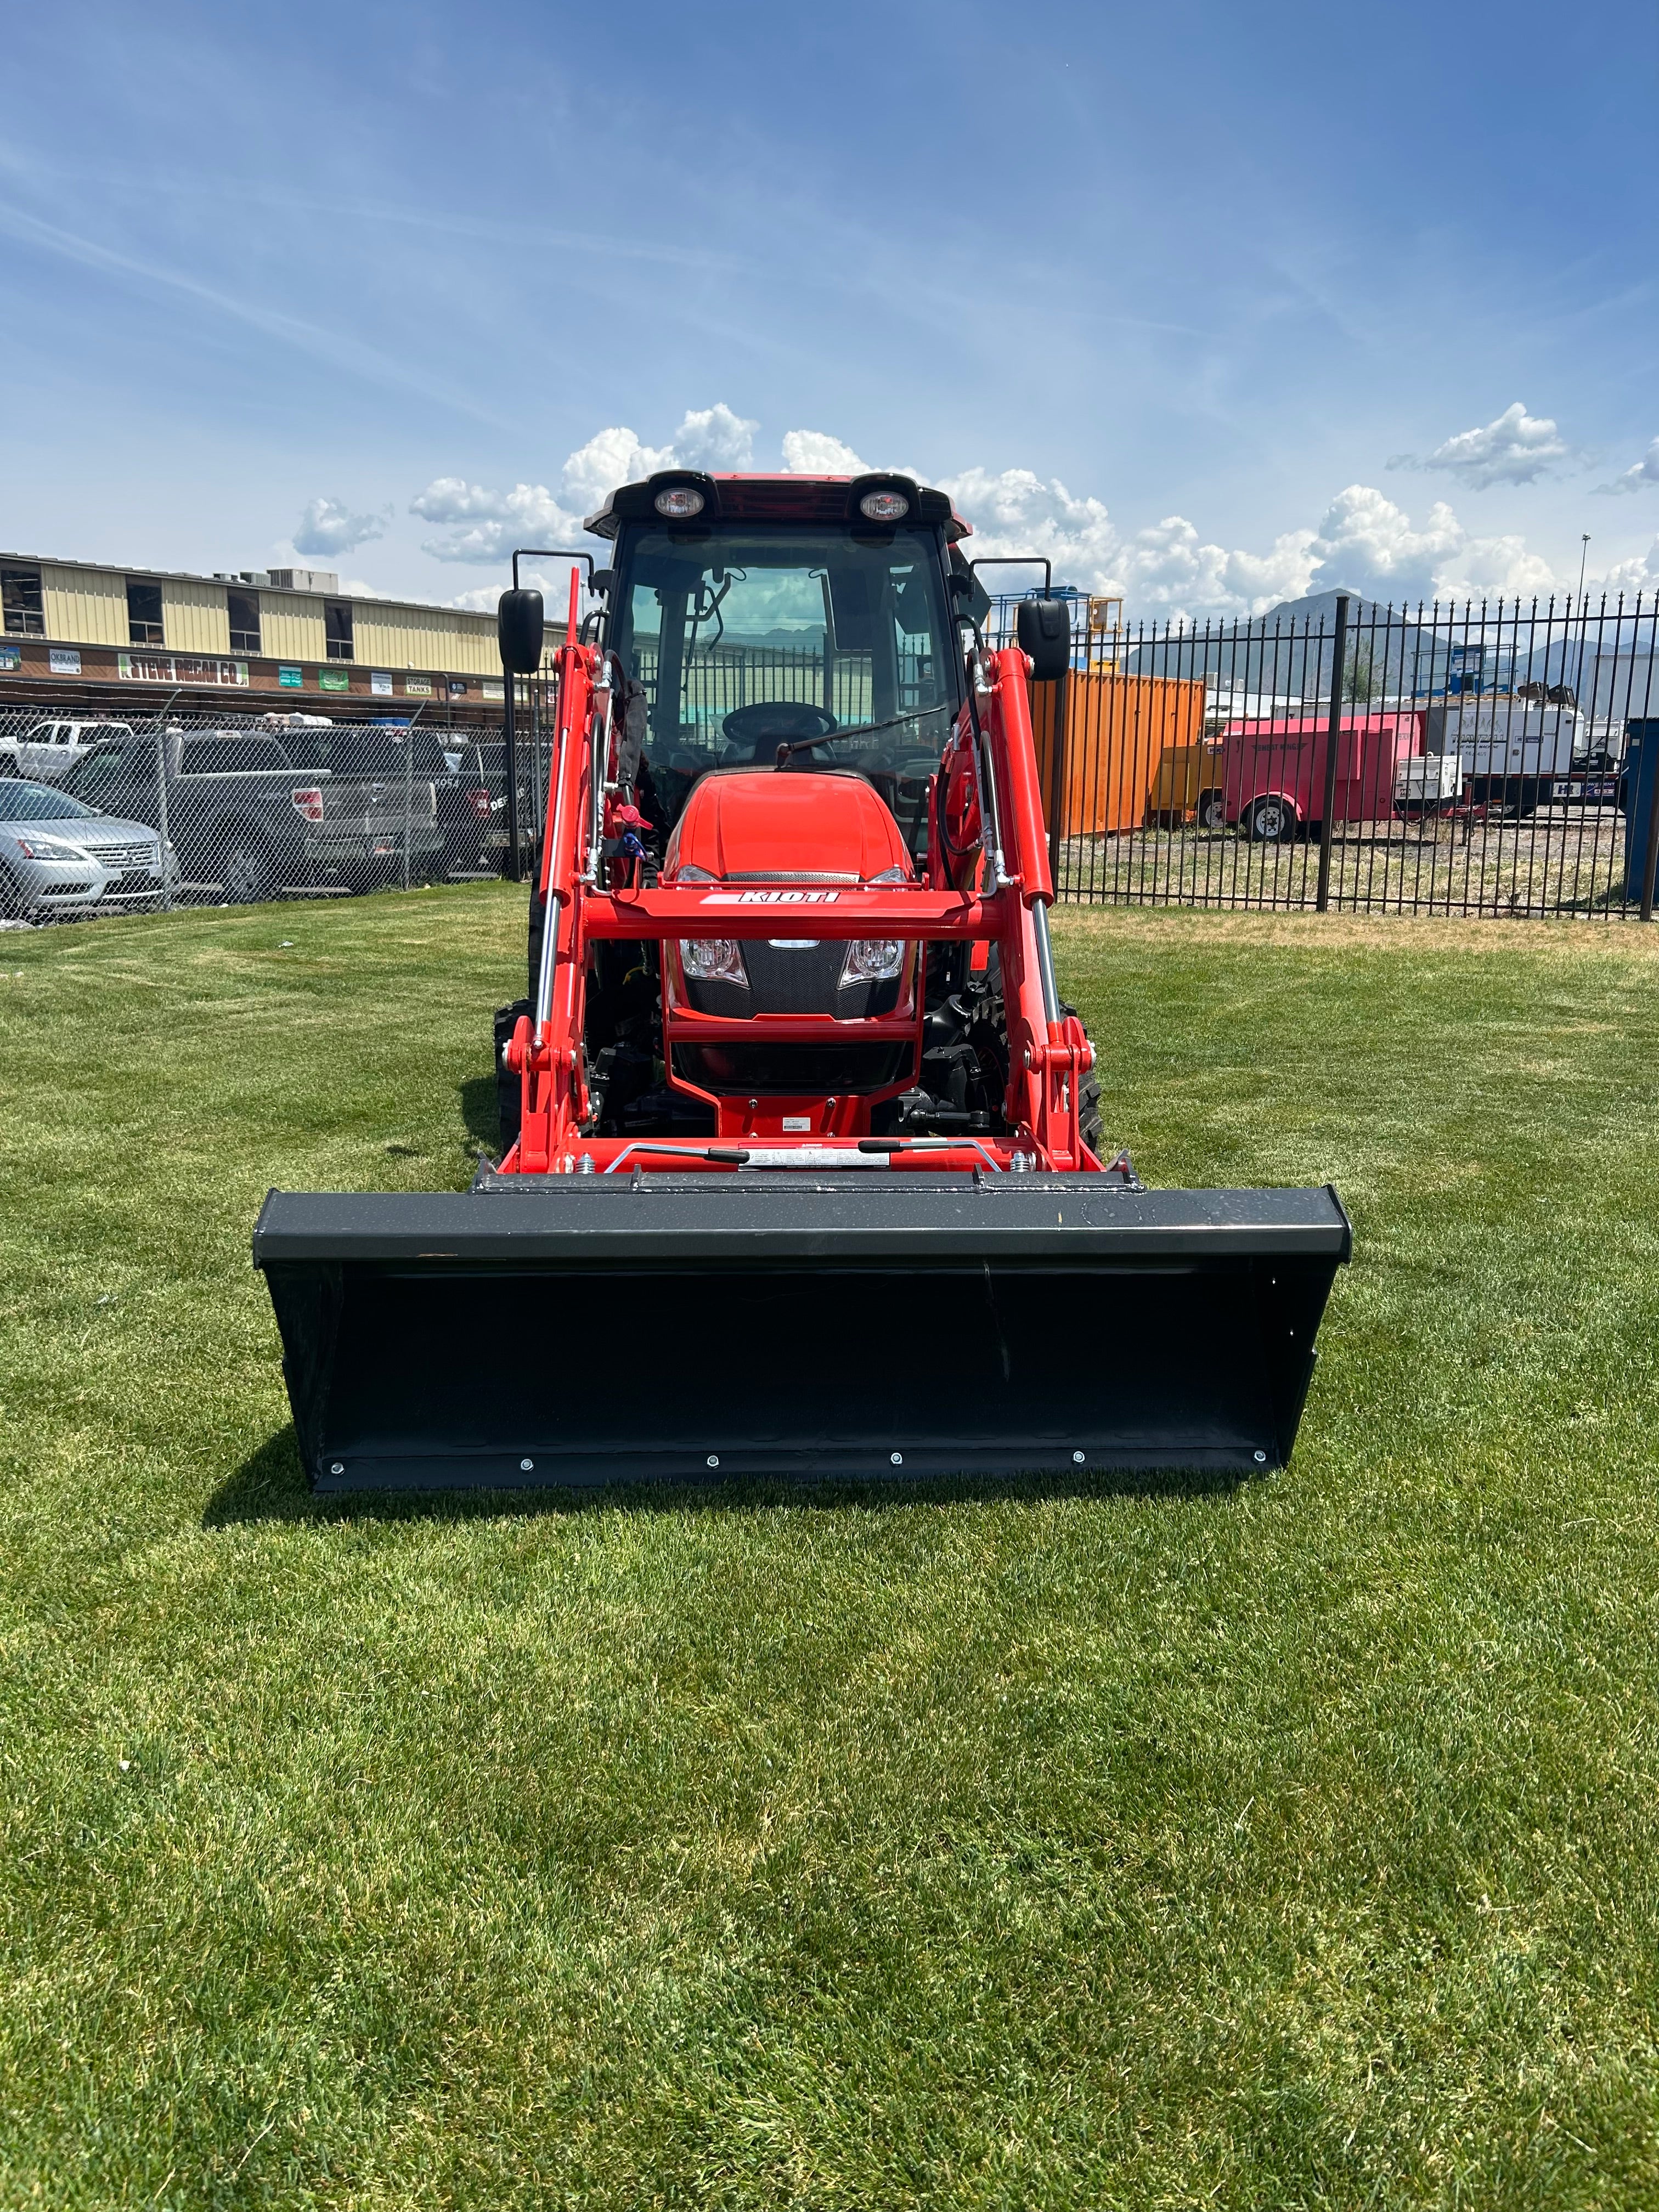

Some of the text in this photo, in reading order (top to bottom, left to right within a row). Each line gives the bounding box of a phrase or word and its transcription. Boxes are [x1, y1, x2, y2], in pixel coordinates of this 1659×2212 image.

[130, 655, 237, 685] STEVE REGAN CO
[407, 678, 431, 686] STORAGE
[738, 891, 842, 903] KIOTI
